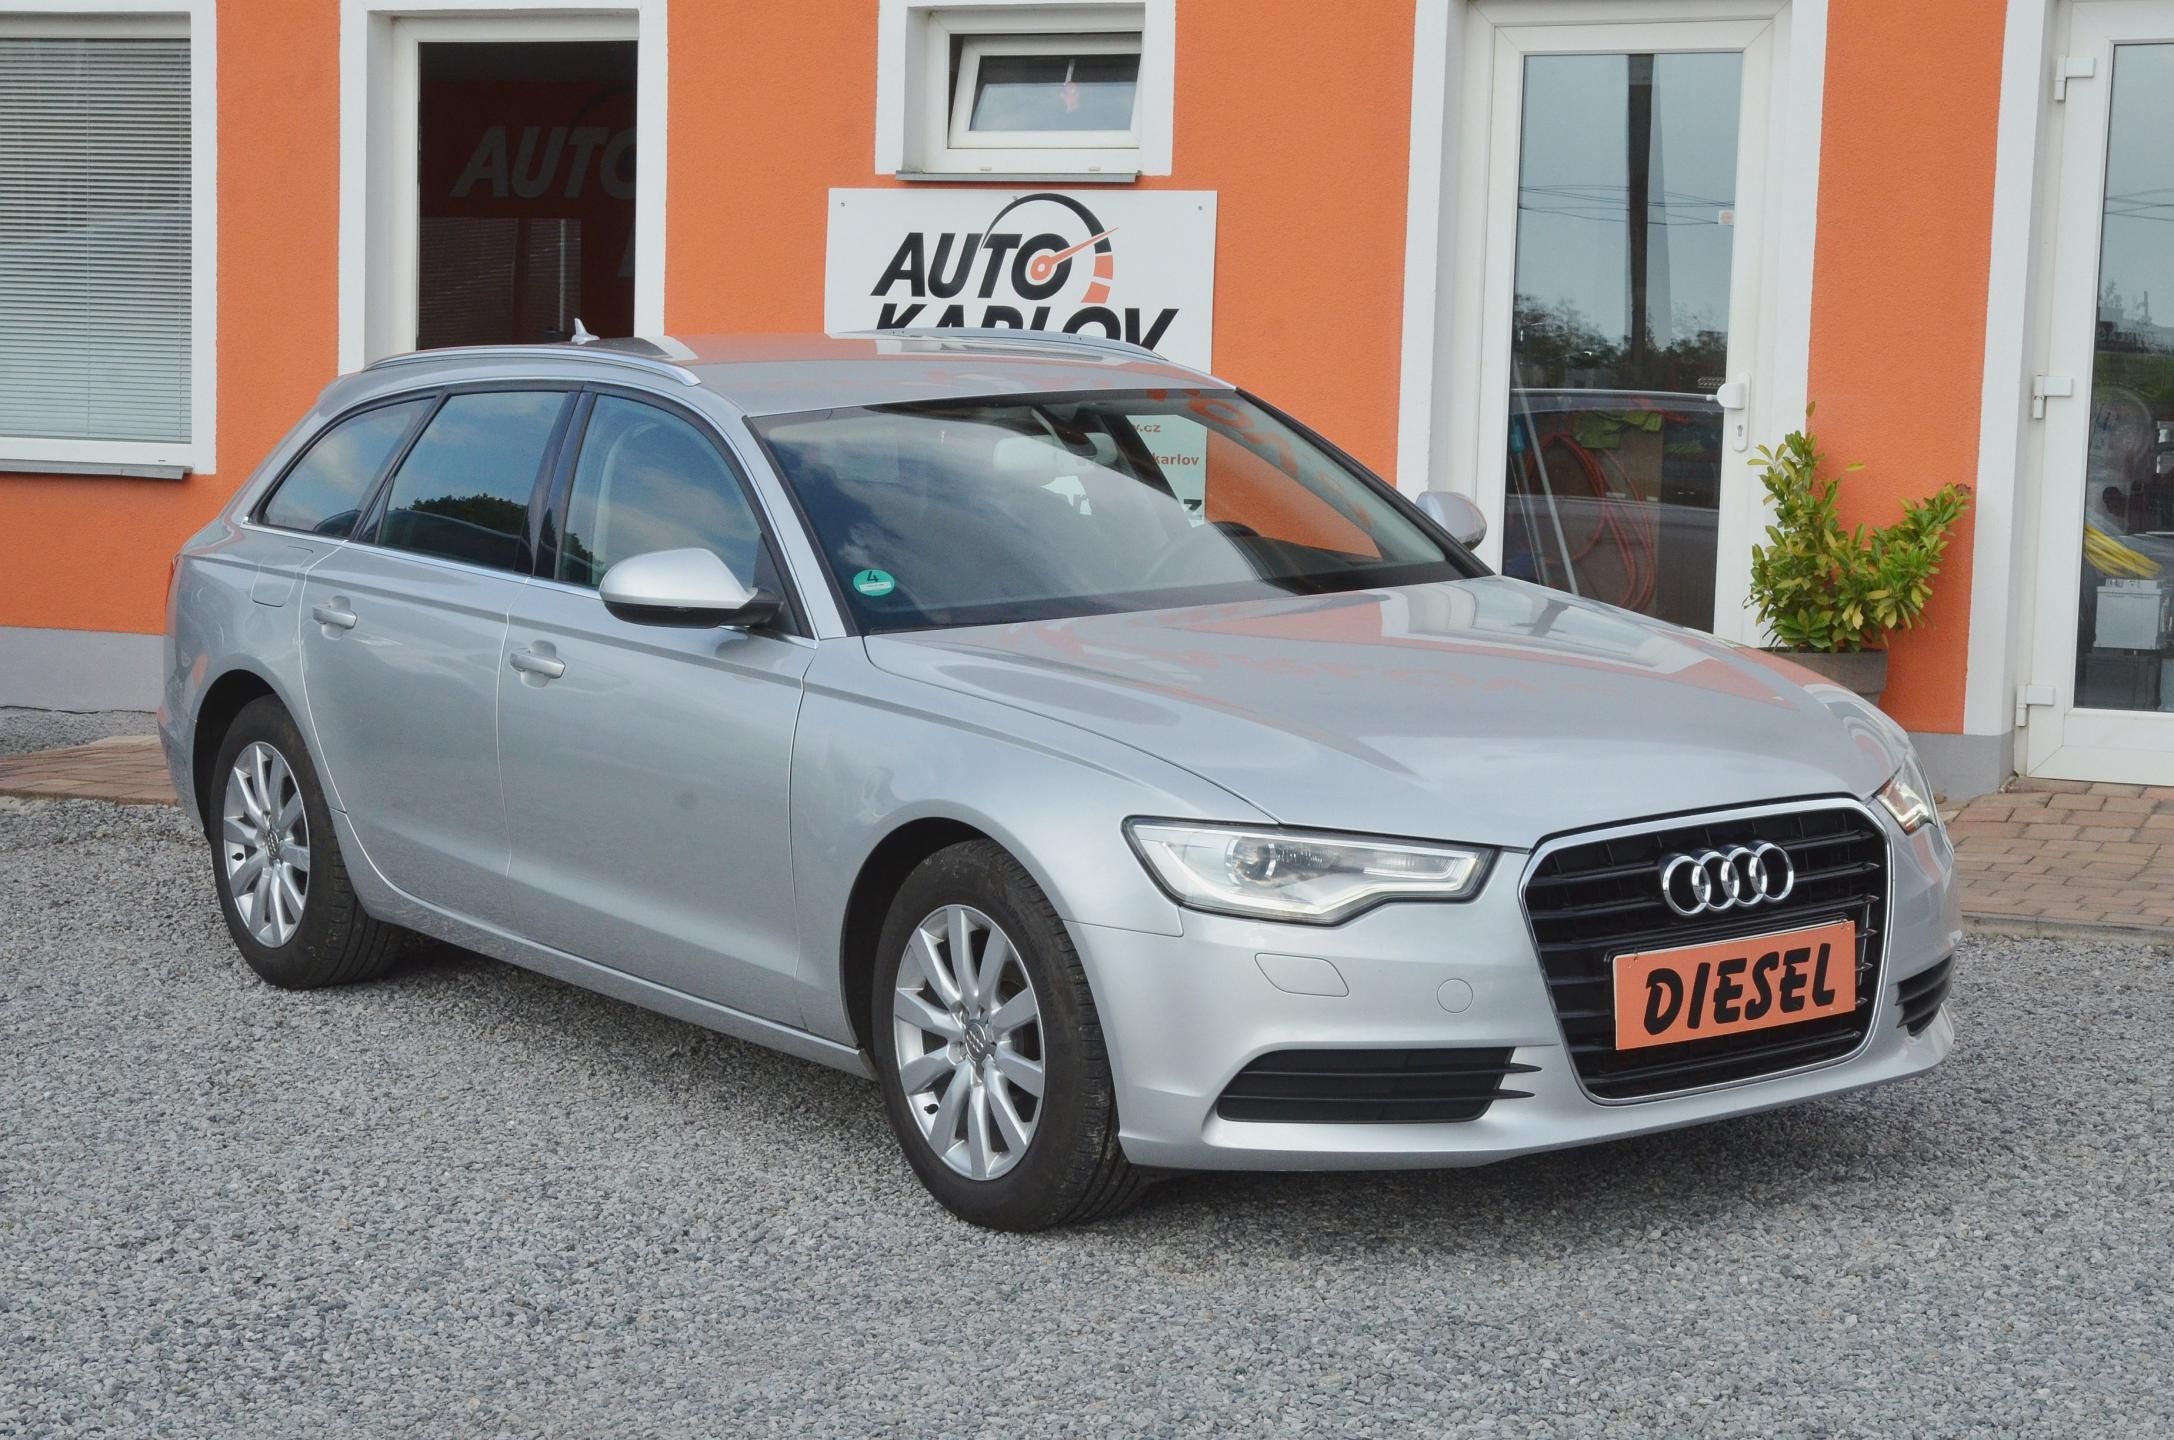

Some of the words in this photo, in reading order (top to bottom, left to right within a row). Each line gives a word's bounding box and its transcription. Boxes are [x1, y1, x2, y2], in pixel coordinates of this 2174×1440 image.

[870, 232, 1073, 301] AUTO
[866, 570, 879, 582] 4
[1643, 942, 1836, 1036] DIESEL
